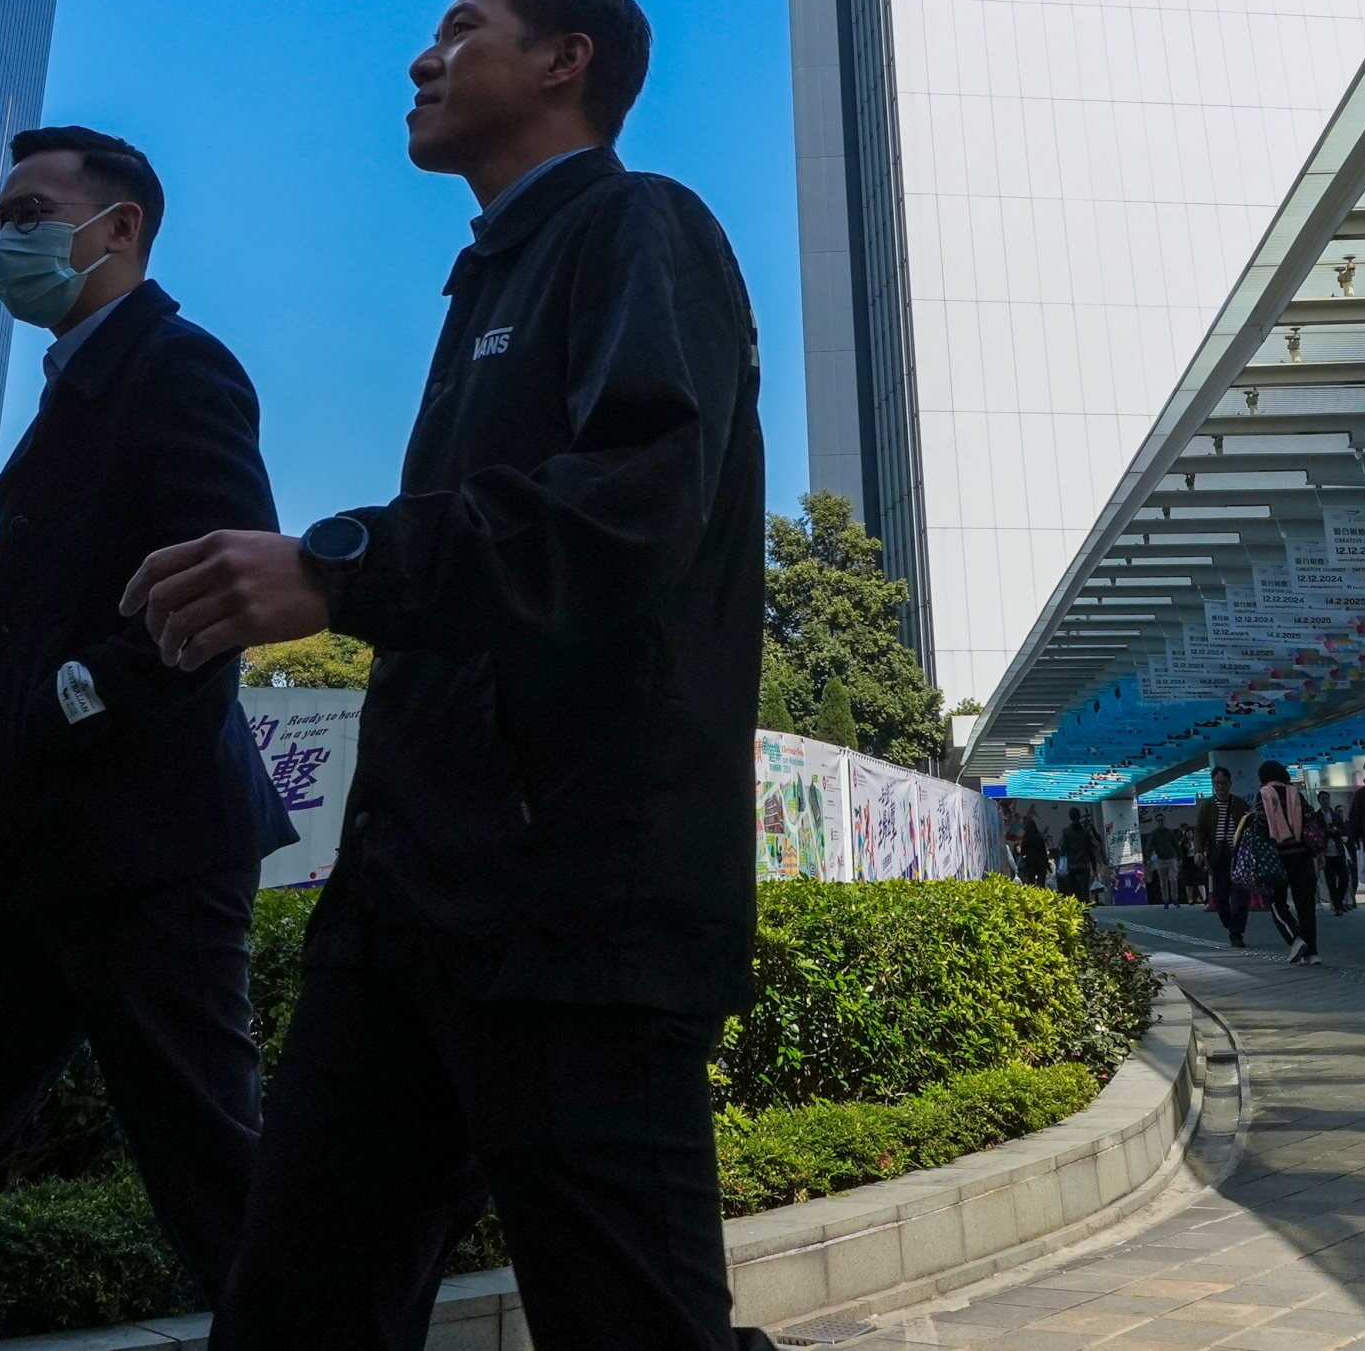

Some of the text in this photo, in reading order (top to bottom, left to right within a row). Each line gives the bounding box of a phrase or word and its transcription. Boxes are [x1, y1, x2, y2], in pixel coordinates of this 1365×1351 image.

[473, 326, 514, 361] VANS
[1297, 575, 1343, 583] 12.12.2024
[288, 713, 324, 725] Ready
[339, 710, 361, 720] host
[280, 728, 330, 740] in a year
